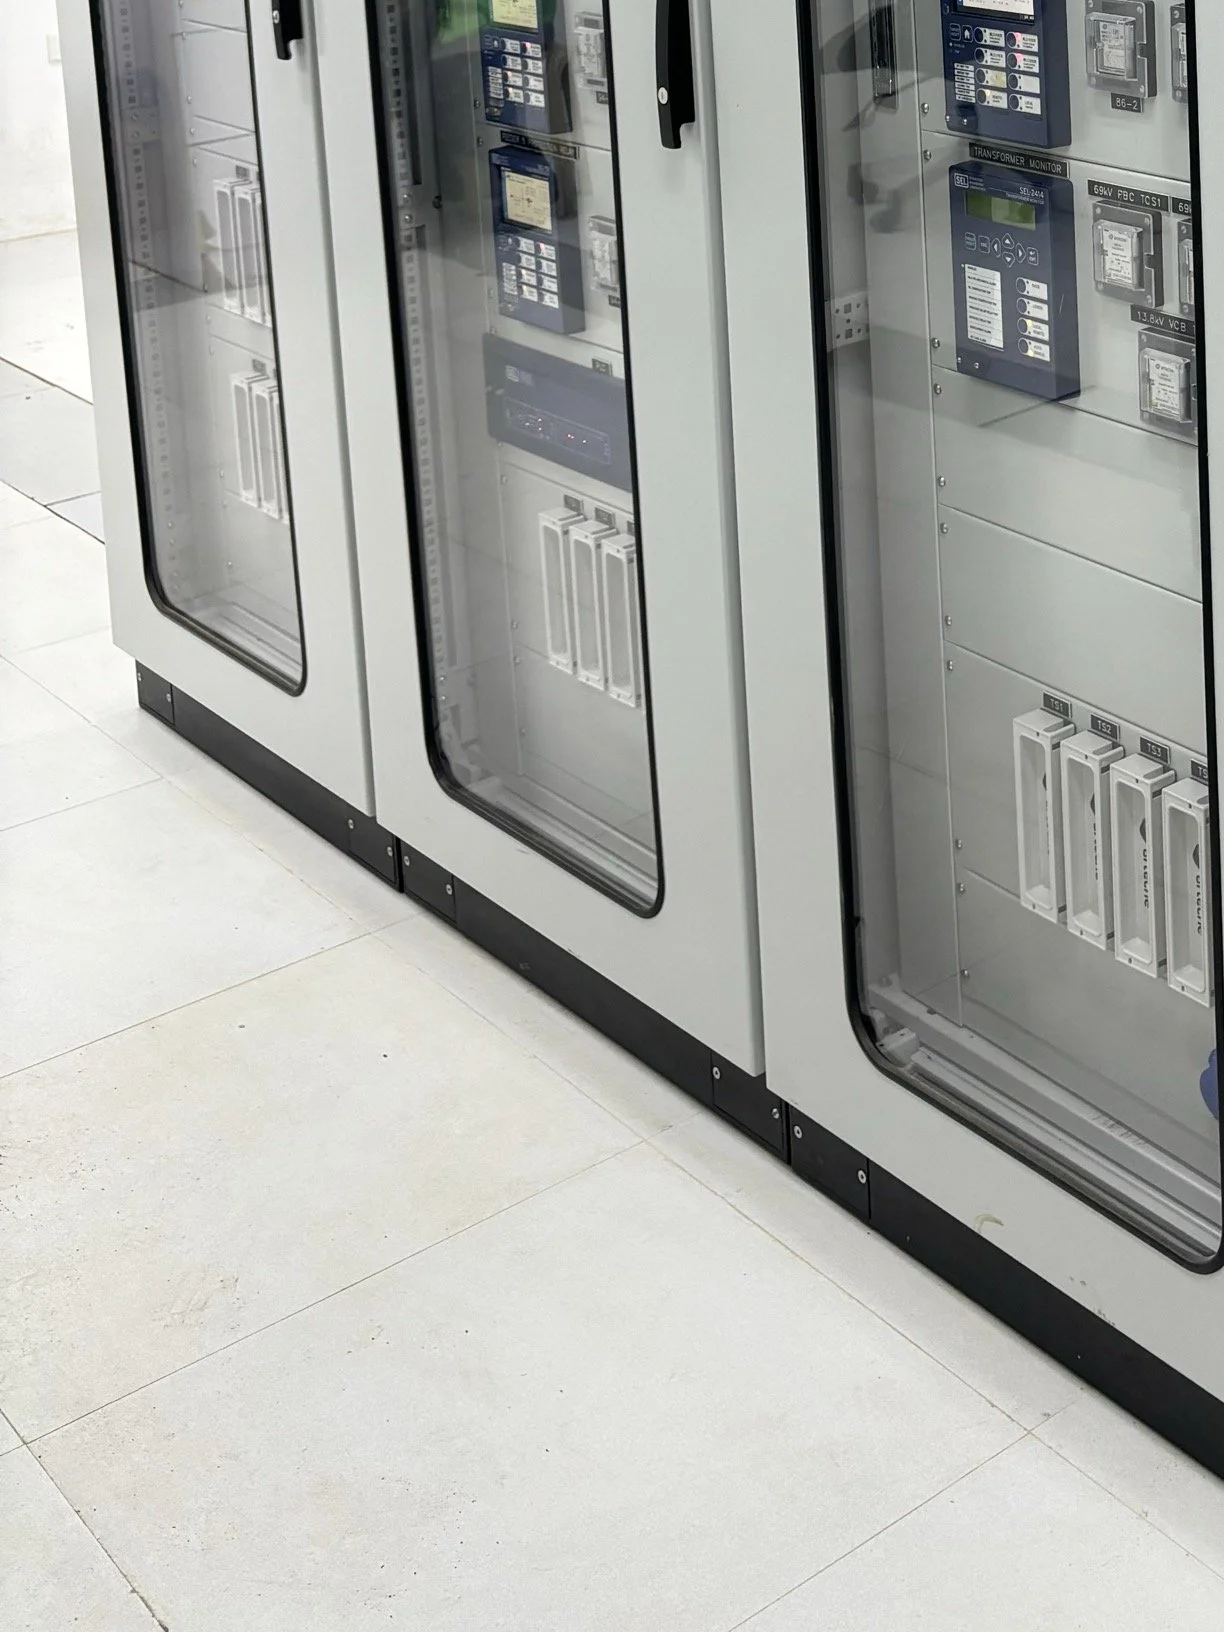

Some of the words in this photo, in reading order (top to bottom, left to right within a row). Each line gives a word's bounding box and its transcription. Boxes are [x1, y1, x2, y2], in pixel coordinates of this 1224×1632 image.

[1115, 97, 1139, 110] 86-2
[974, 146, 1025, 166] TRANSFORMER
[1029, 157, 1062, 173] MONITOR
[955, 175, 968, 187] SEL
[1093, 184, 1113, 197] 69kV
[1140, 194, 1161, 208] TCS1
[1137, 311, 1165, 326] 13.8kV
[1169, 318, 1187, 333] VCB
